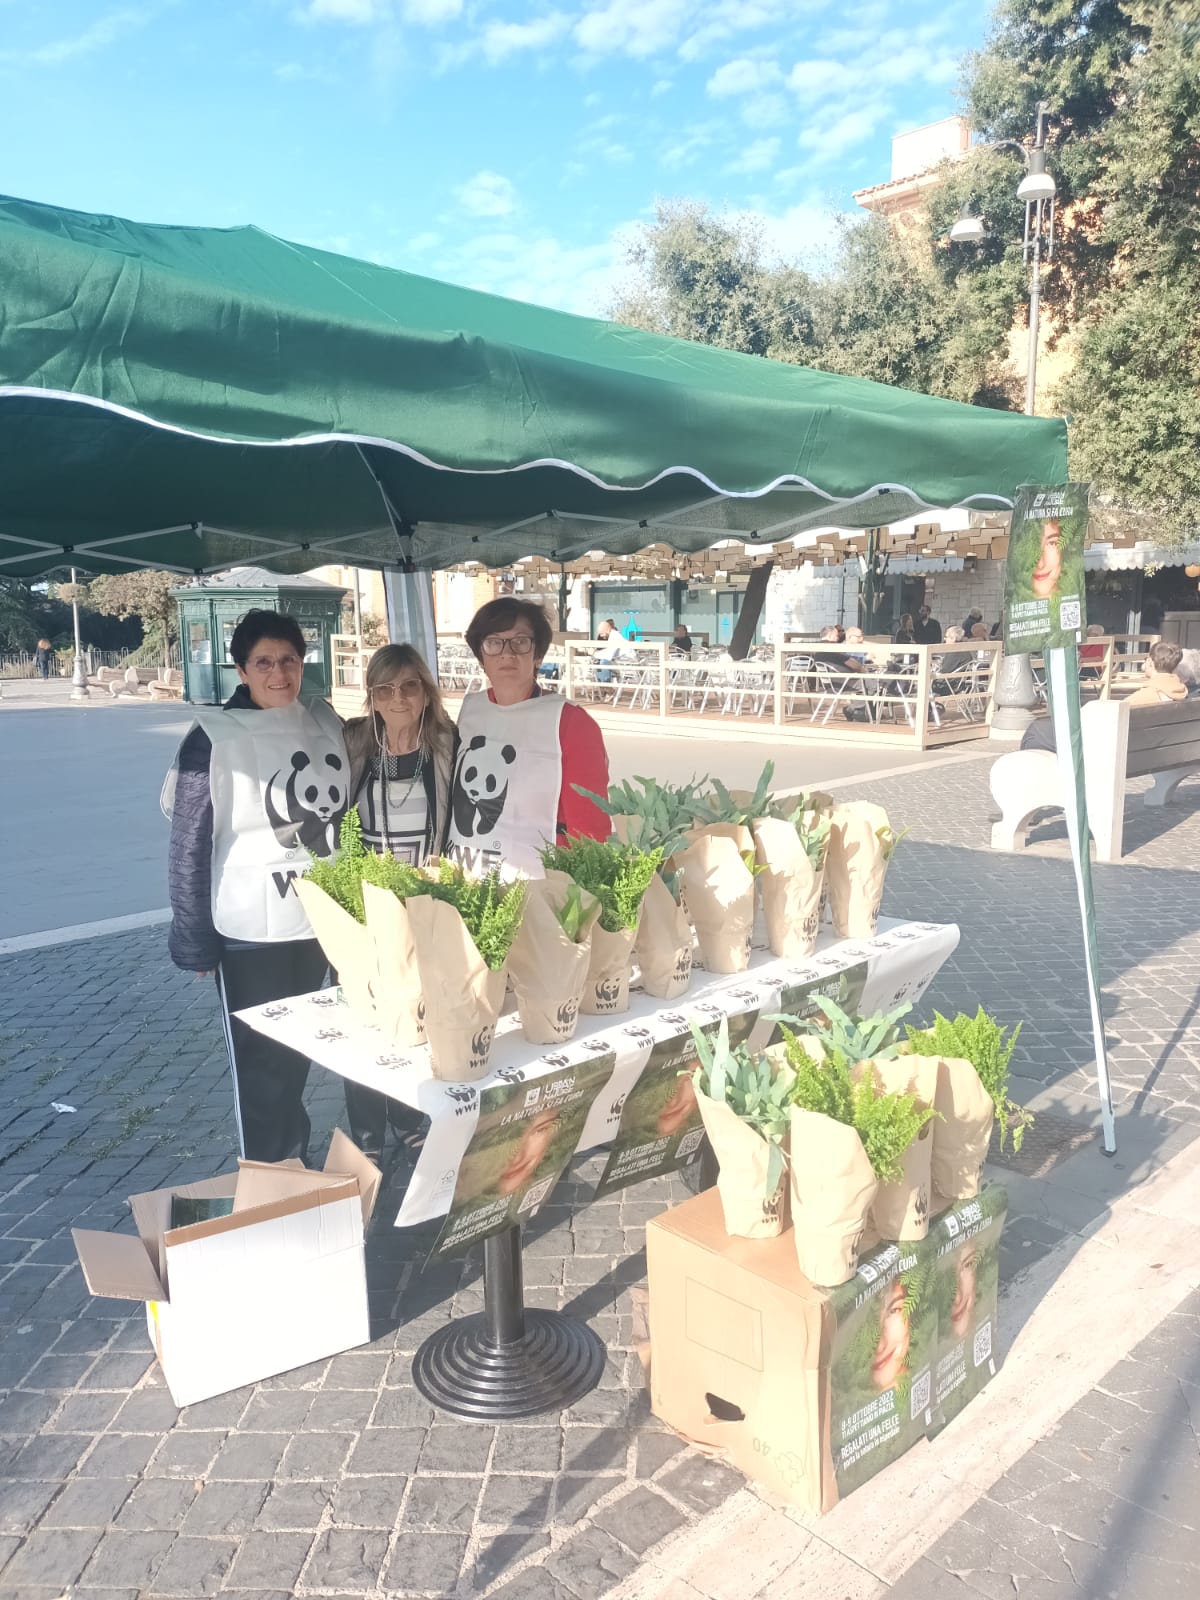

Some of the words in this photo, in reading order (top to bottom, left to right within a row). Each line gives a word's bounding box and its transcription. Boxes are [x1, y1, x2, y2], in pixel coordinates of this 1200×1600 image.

[856, 1294, 864, 1309] LA
[899, 1253, 918, 1272] CURA
[853, 1399, 879, 1424] OTTOBRE
[879, 1390, 894, 1408] 2022
[841, 1431, 868, 1459] REGALATI
[869, 1423, 881, 1441] UNA
[882, 1413, 900, 1433] FELCE
